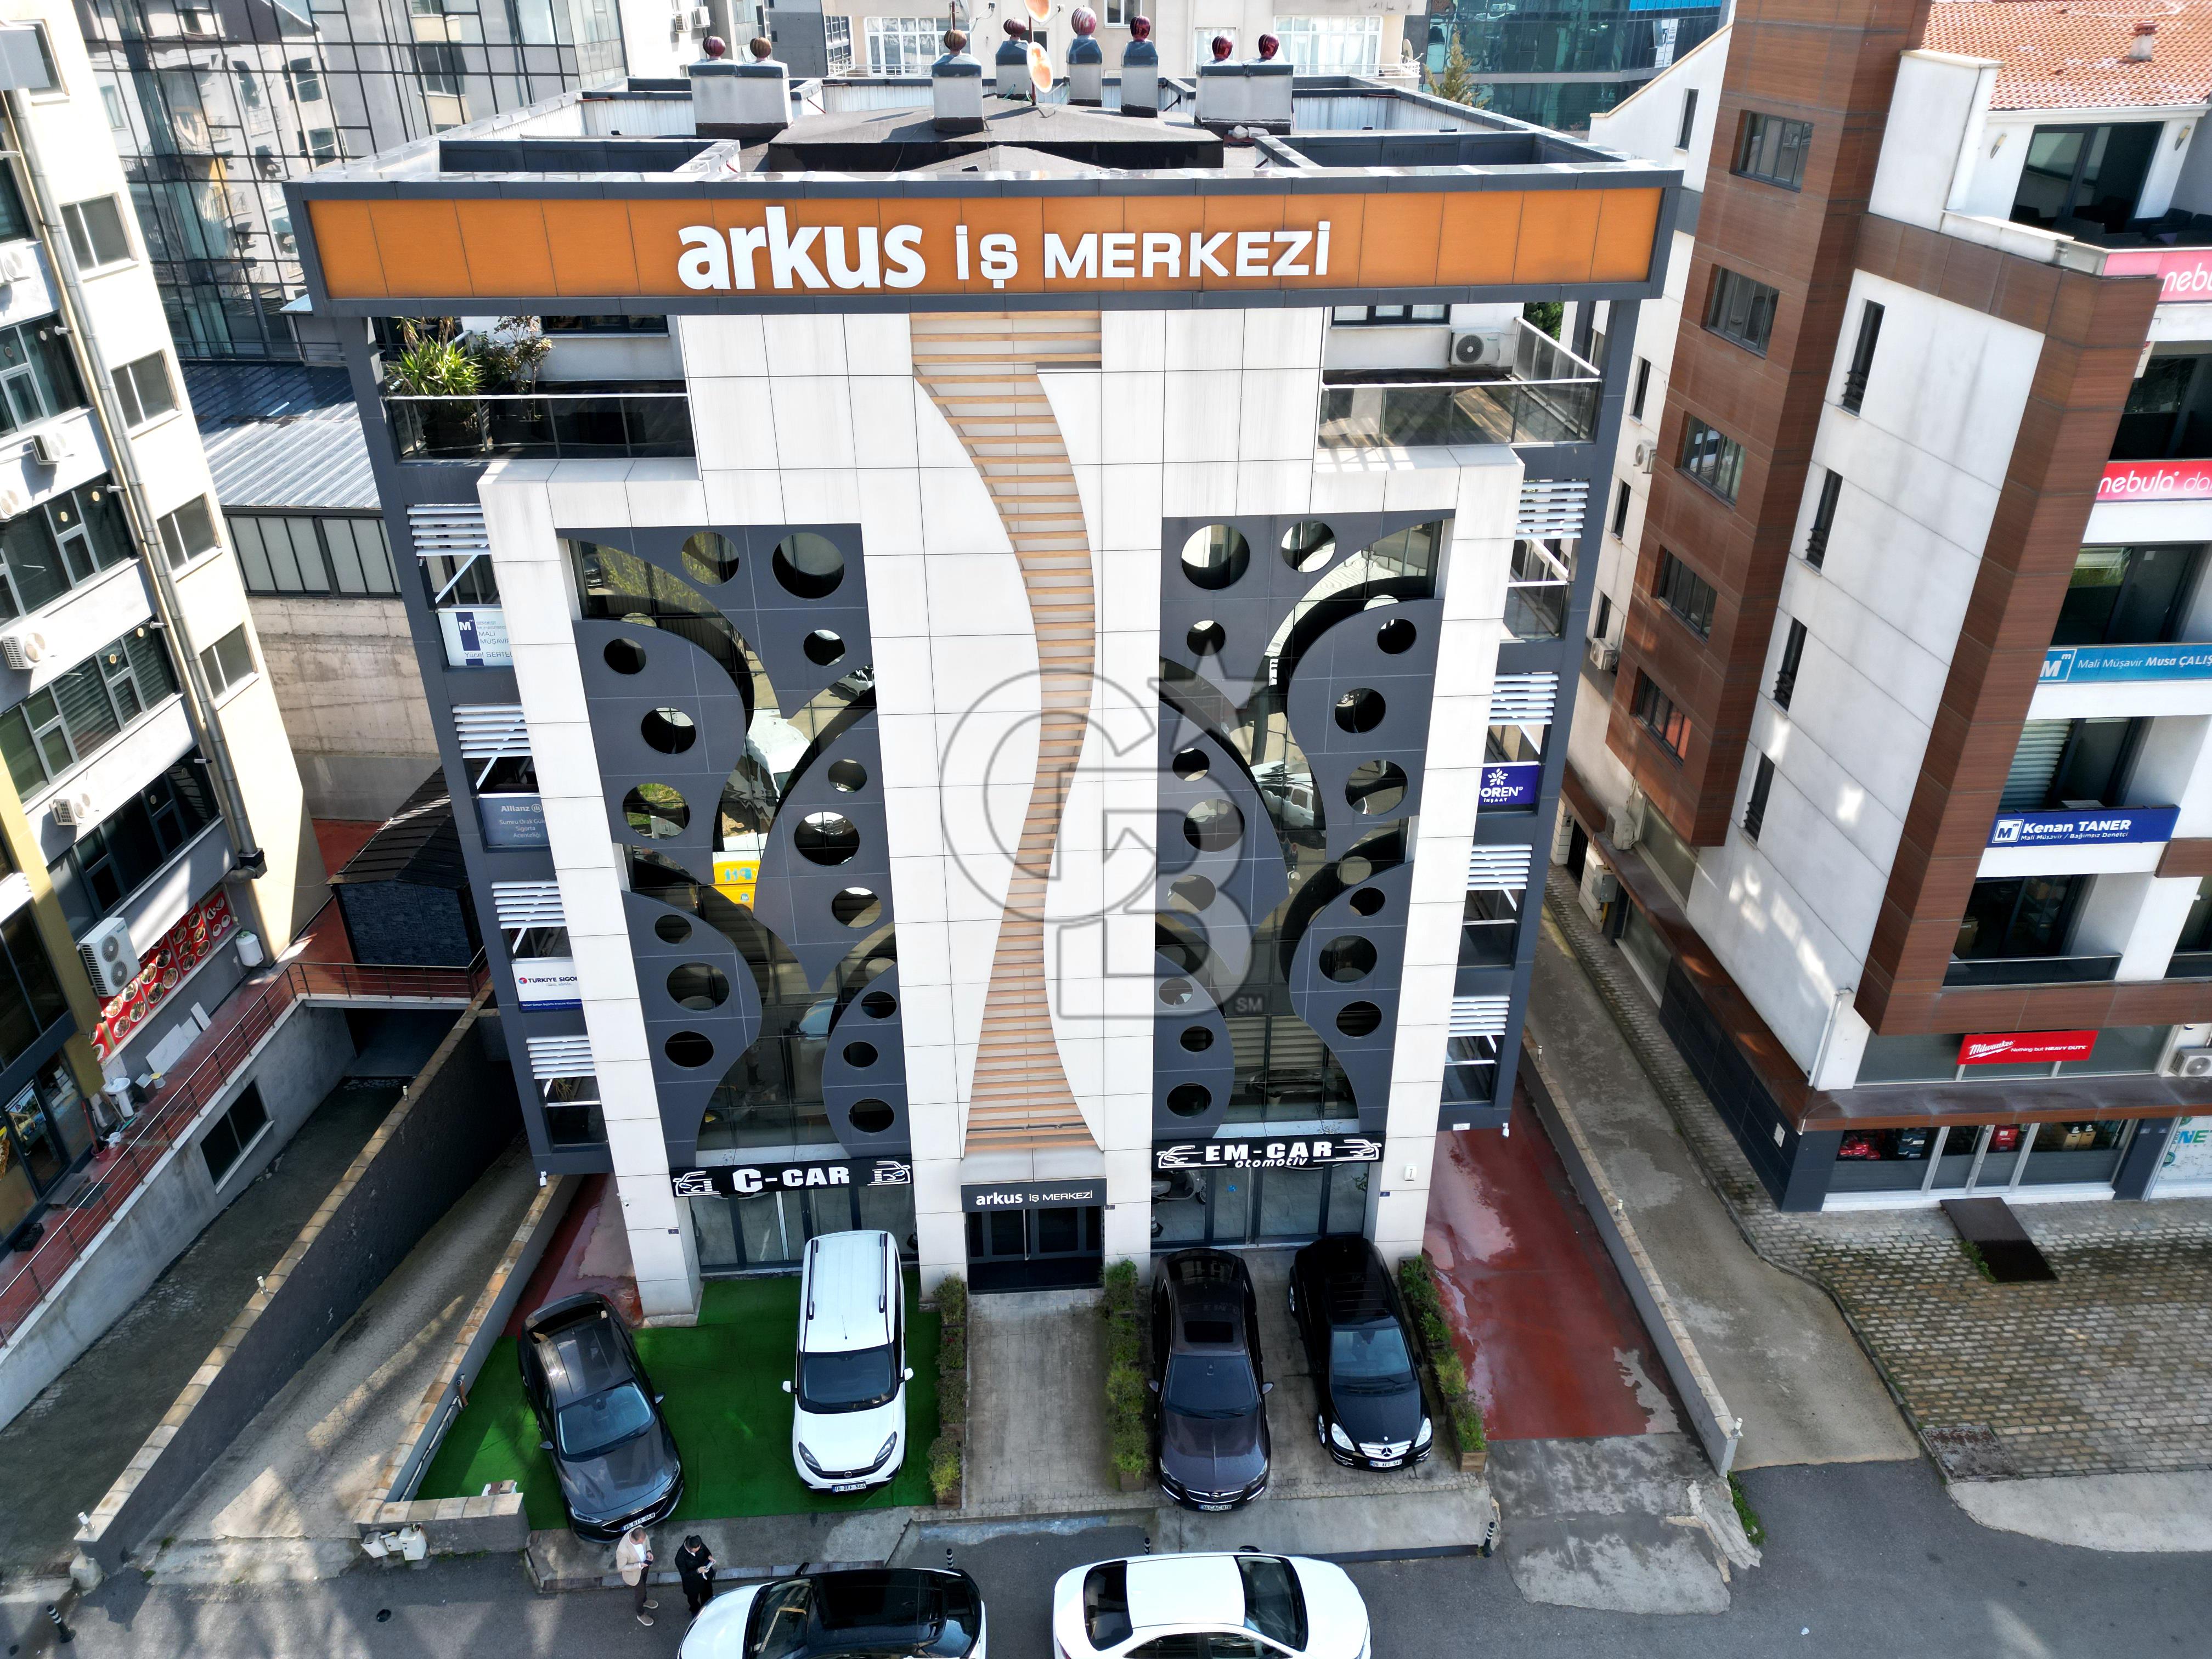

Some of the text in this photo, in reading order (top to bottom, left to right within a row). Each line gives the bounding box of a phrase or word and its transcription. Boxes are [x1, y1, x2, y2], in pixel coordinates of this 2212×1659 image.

[678, 206, 926, 290] arkus
[1045, 221, 1330, 278] MERKEZİ
[2184, 471, 2212, 492] da
[2145, 657, 2176, 666] Musa
[2023, 820, 2131, 833] Kenan TANER
[1968, 1040, 2014, 1055] Milwaukee
[1206, 1141, 1332, 1161] EM-CAR
[732, 1166, 850, 1193] C-CAR
[976, 1192, 1023, 1205] arkus
